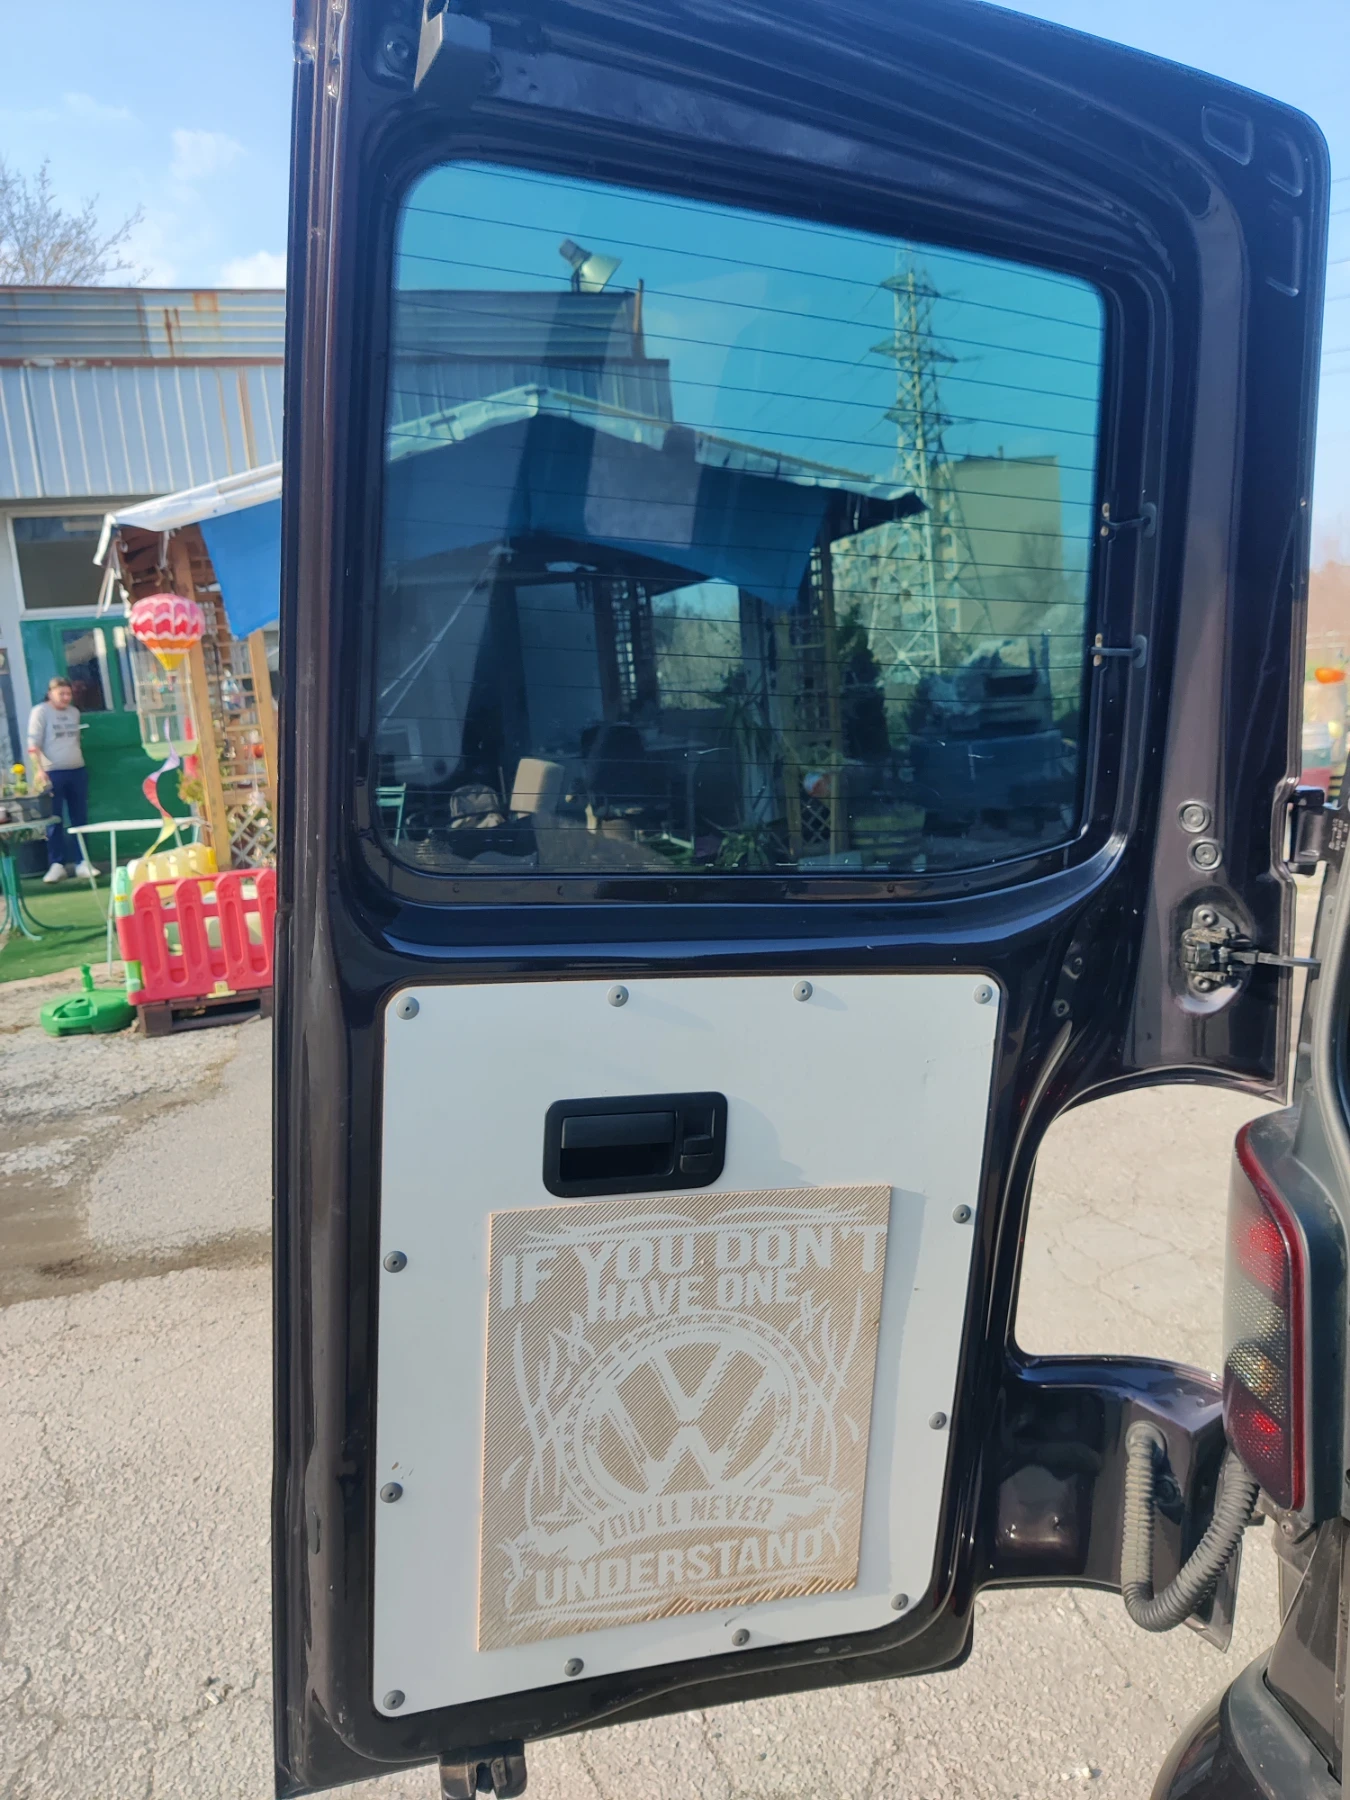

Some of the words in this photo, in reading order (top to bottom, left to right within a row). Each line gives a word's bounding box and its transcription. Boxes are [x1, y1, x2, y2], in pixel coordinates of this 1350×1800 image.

[500, 1250, 557, 1313] IF
[573, 1232, 696, 1288] YOU
[714, 1225, 889, 1274] DON'T
[586, 1273, 704, 1325] HAVE
[715, 1268, 801, 1309] ONE
[587, 1499, 682, 1547] YOU'LL
[689, 1494, 775, 1524] NEVER
[534, 1527, 823, 1606] UNDERSTAND
